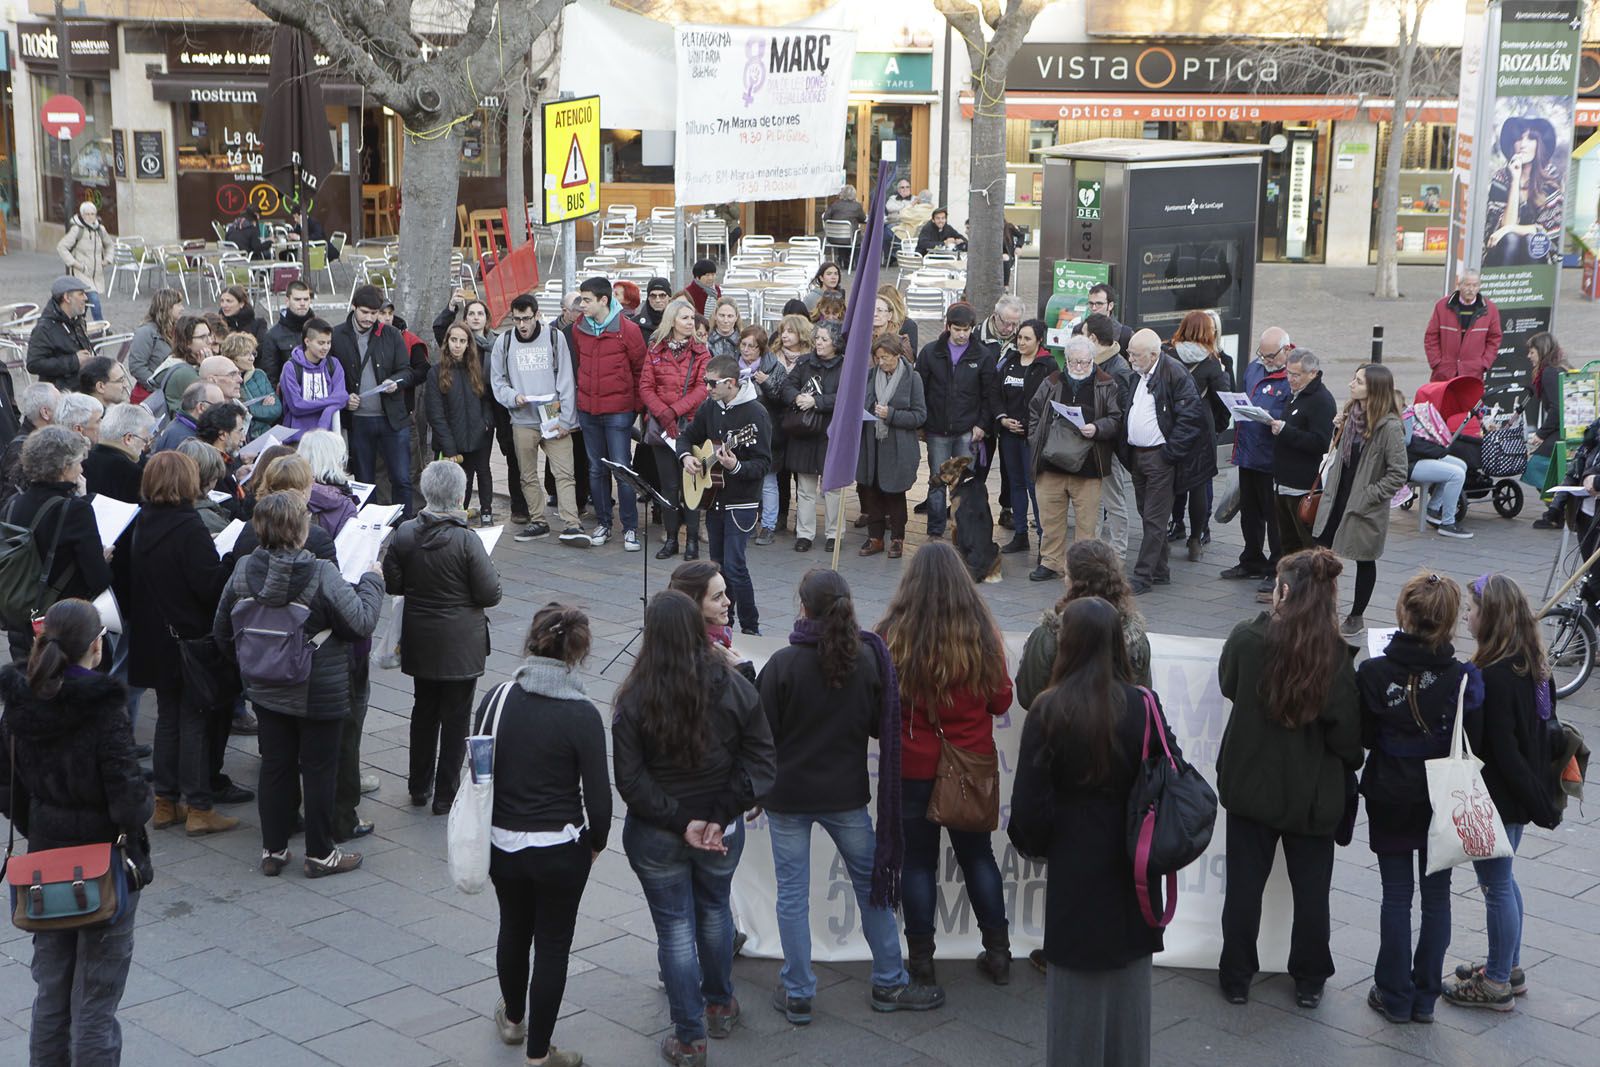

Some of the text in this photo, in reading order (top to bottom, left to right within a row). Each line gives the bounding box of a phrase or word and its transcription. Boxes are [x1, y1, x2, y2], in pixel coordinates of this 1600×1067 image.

[769, 34, 831, 76] MARÇ
[1499, 49, 1573, 72] ROZALÉN
[884, 56, 900, 75] A
[887, 80, 914, 89] TAPES
[191, 88, 258, 102] nostrum
[555, 102, 592, 128] ATENCIÓ
[732, 116, 757, 129] Marxa
[760, 115, 771, 128] de
[772, 114, 801, 127] torxes
[224, 126, 241, 146] La
[567, 192, 584, 211] BUS
[1078, 208, 1099, 218] DEA
